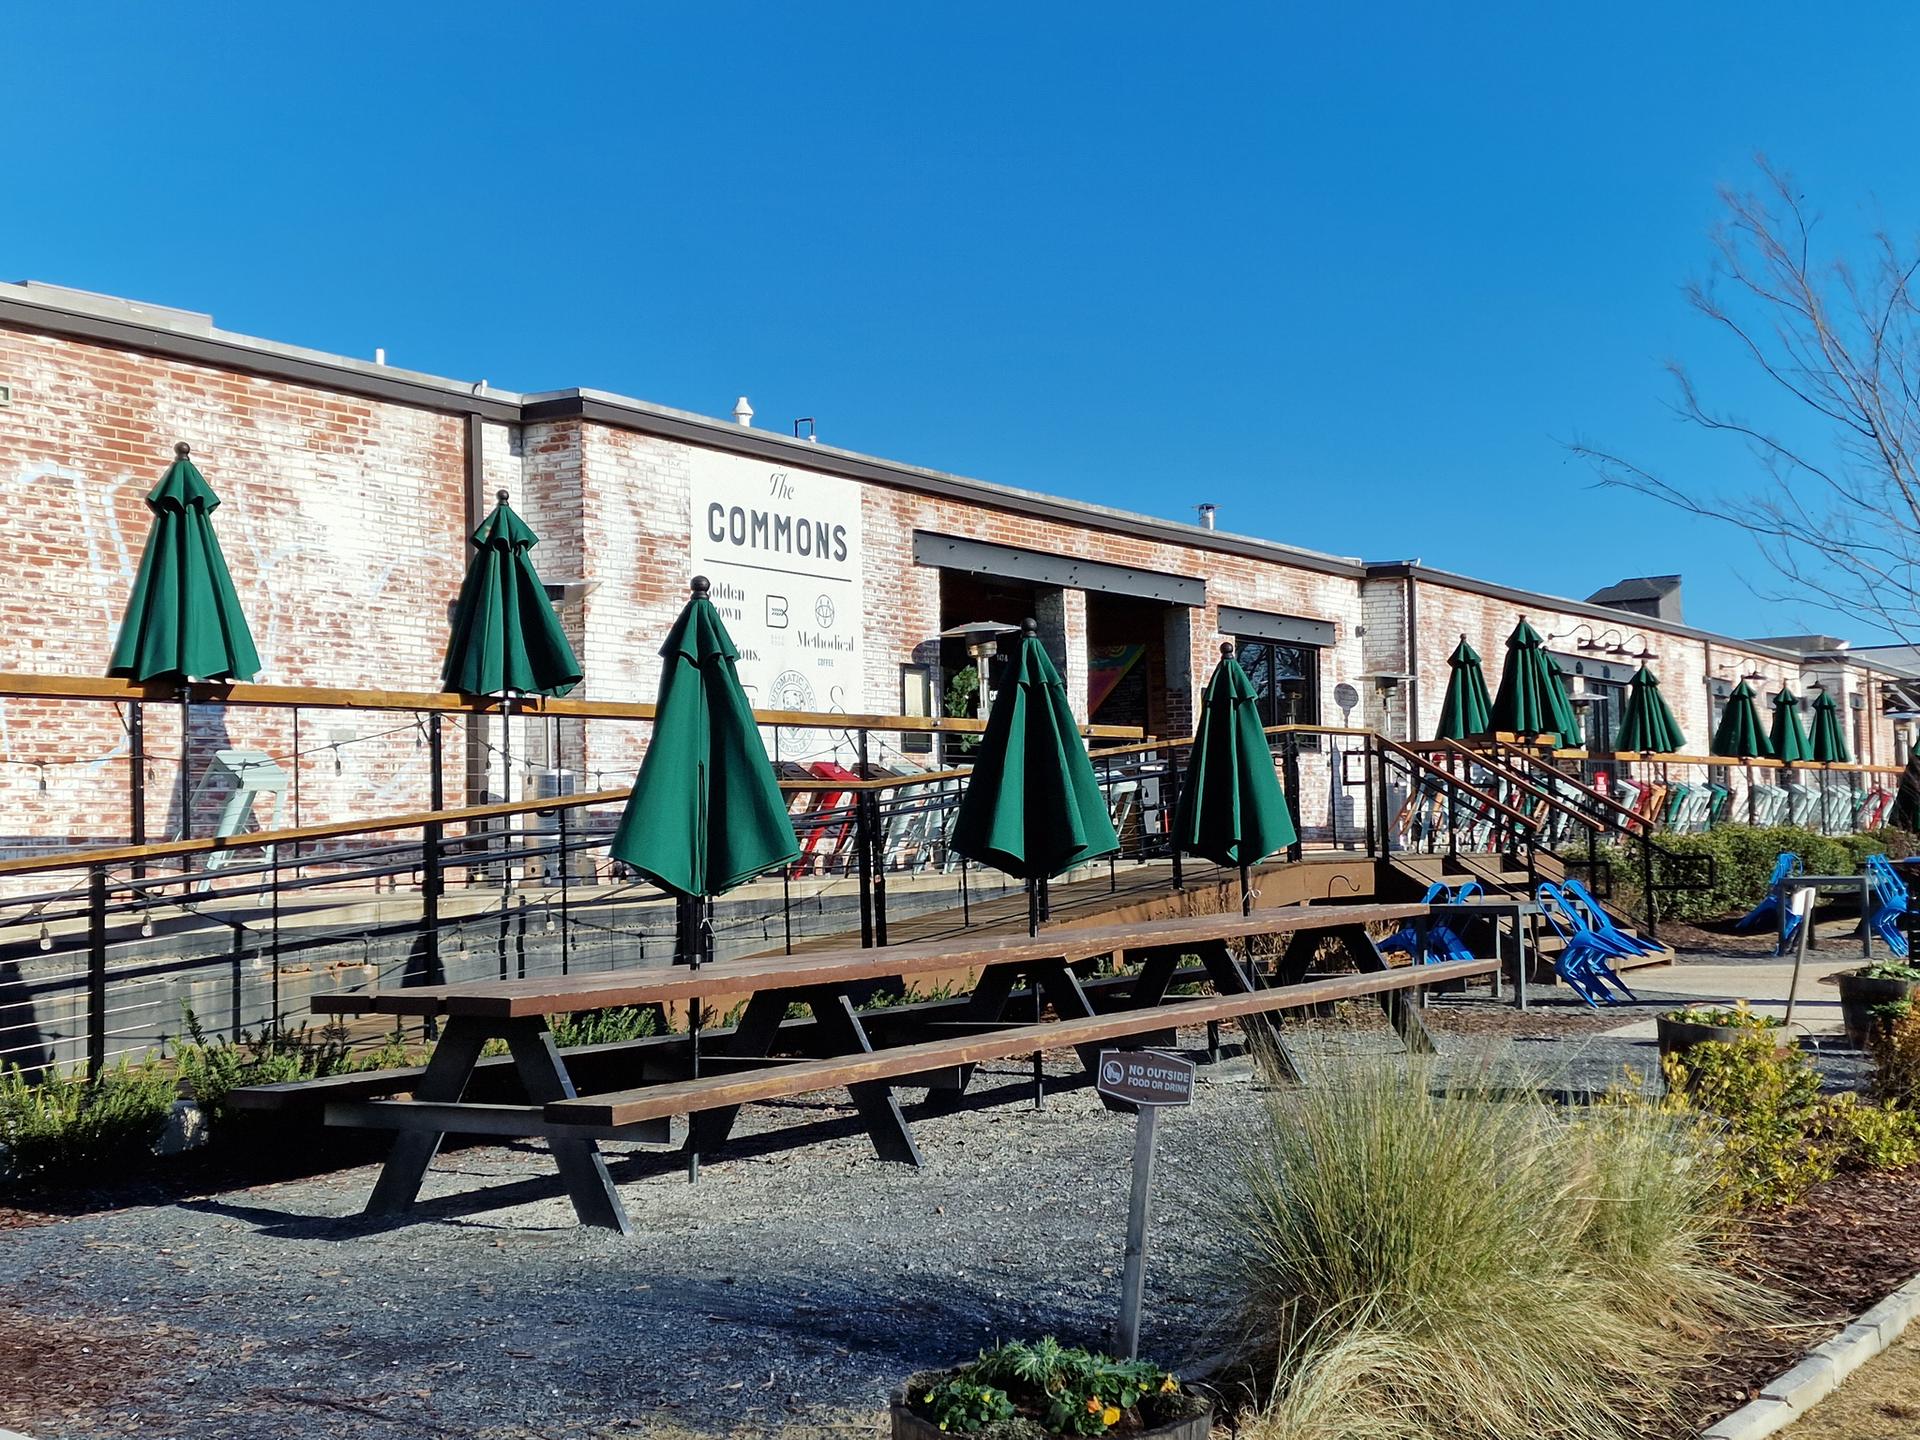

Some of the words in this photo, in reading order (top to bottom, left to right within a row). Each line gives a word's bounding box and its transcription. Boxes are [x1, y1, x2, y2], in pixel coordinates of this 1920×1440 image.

[769, 472, 795, 500] The
[707, 502, 848, 562] COMMONS
[708, 582, 745, 602] olden
[715, 606, 742, 621] own
[796, 630, 854, 652] Methodical
[817, 657, 834, 667] COFFEE
[1128, 1064, 1144, 1076] NO
[1146, 1067, 1190, 1083] OUTSIDE
[1127, 1076, 1150, 1088] FOOD
[1151, 1080, 1163, 1090] OR
[1164, 1082, 1188, 1094] DRINK
